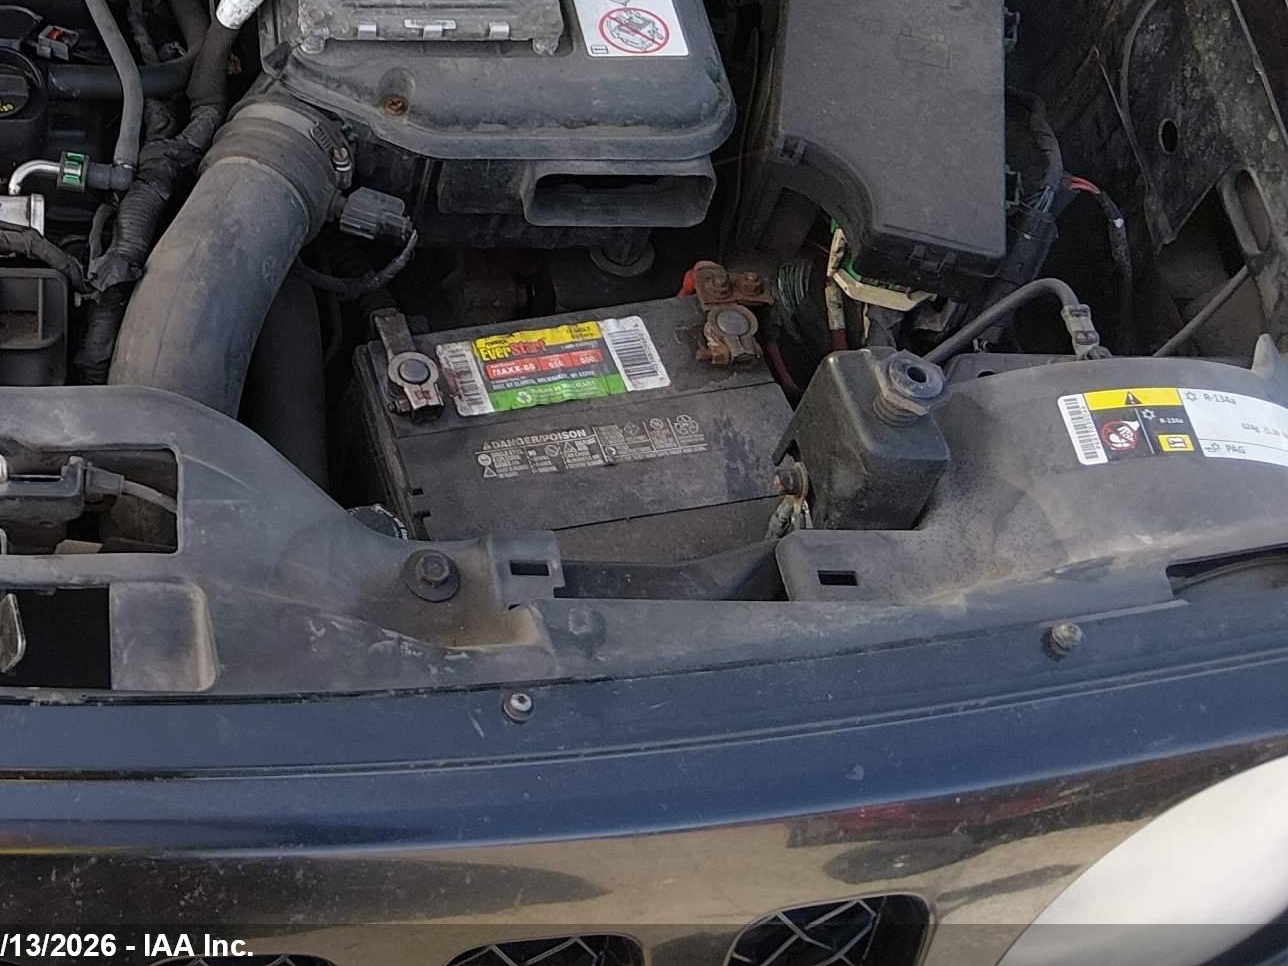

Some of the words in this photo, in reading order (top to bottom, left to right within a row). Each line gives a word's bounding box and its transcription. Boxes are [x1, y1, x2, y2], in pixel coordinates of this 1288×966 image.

[479, 339, 546, 362] EverStart
[1203, 393, 1237, 405] R-134a
[491, 428, 587, 449] DANGER/POISON
[1225, 444, 1246, 454] PAG
